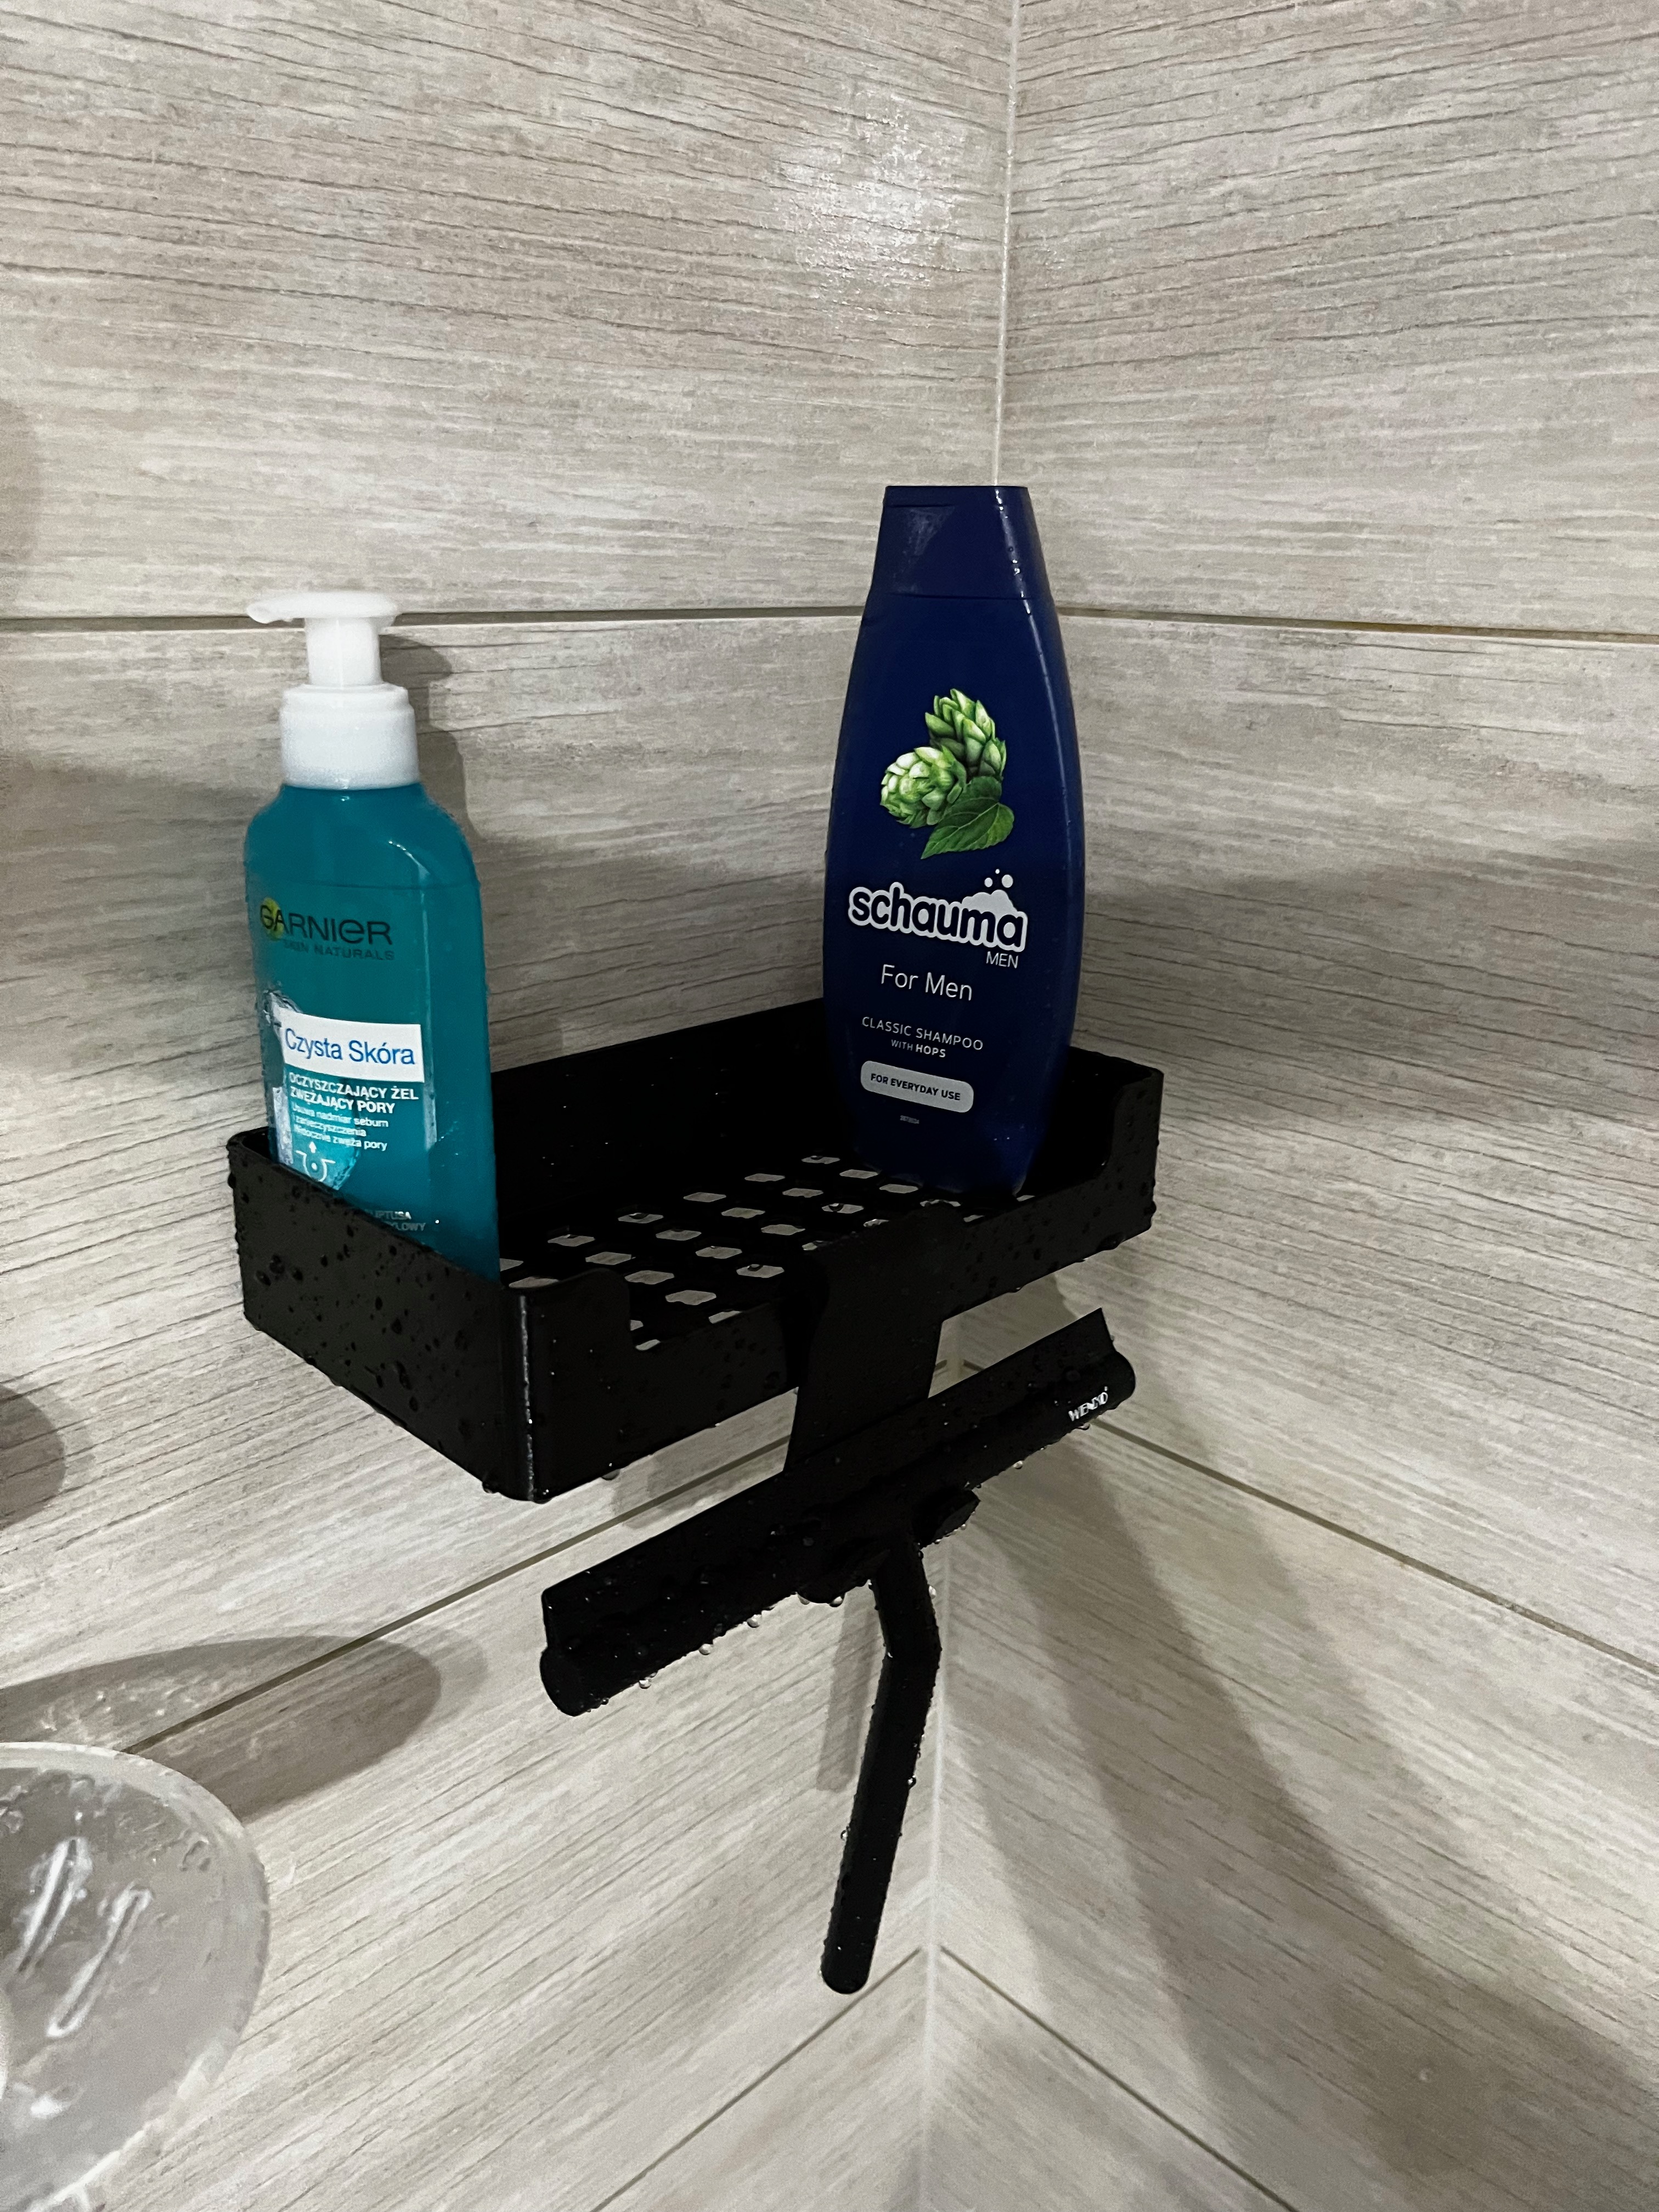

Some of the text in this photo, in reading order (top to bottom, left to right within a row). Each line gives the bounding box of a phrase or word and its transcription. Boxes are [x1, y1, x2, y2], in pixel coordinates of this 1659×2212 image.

[849, 882, 1028, 952] schauma
[314, 944, 395, 961] NATURALS
[986, 951, 1019, 968] MEN
[881, 964, 973, 1001] For Men
[285, 1028, 415, 1065] Czysta Skóra
[862, 1017, 983, 1050] CLASSIC SHAMPOO
[891, 1039, 946, 1058] WITH HOPS
[289, 1071, 419, 1101] OCZYSZCZAJĄCY ŻEL
[290, 1086, 396, 1114] ZWĘŻAJĄCY PORY
[871, 1073, 961, 1101] FOR EVERYDAY USE
[354, 1117, 389, 1127] sebum
[364, 1141, 388, 1152] pory
